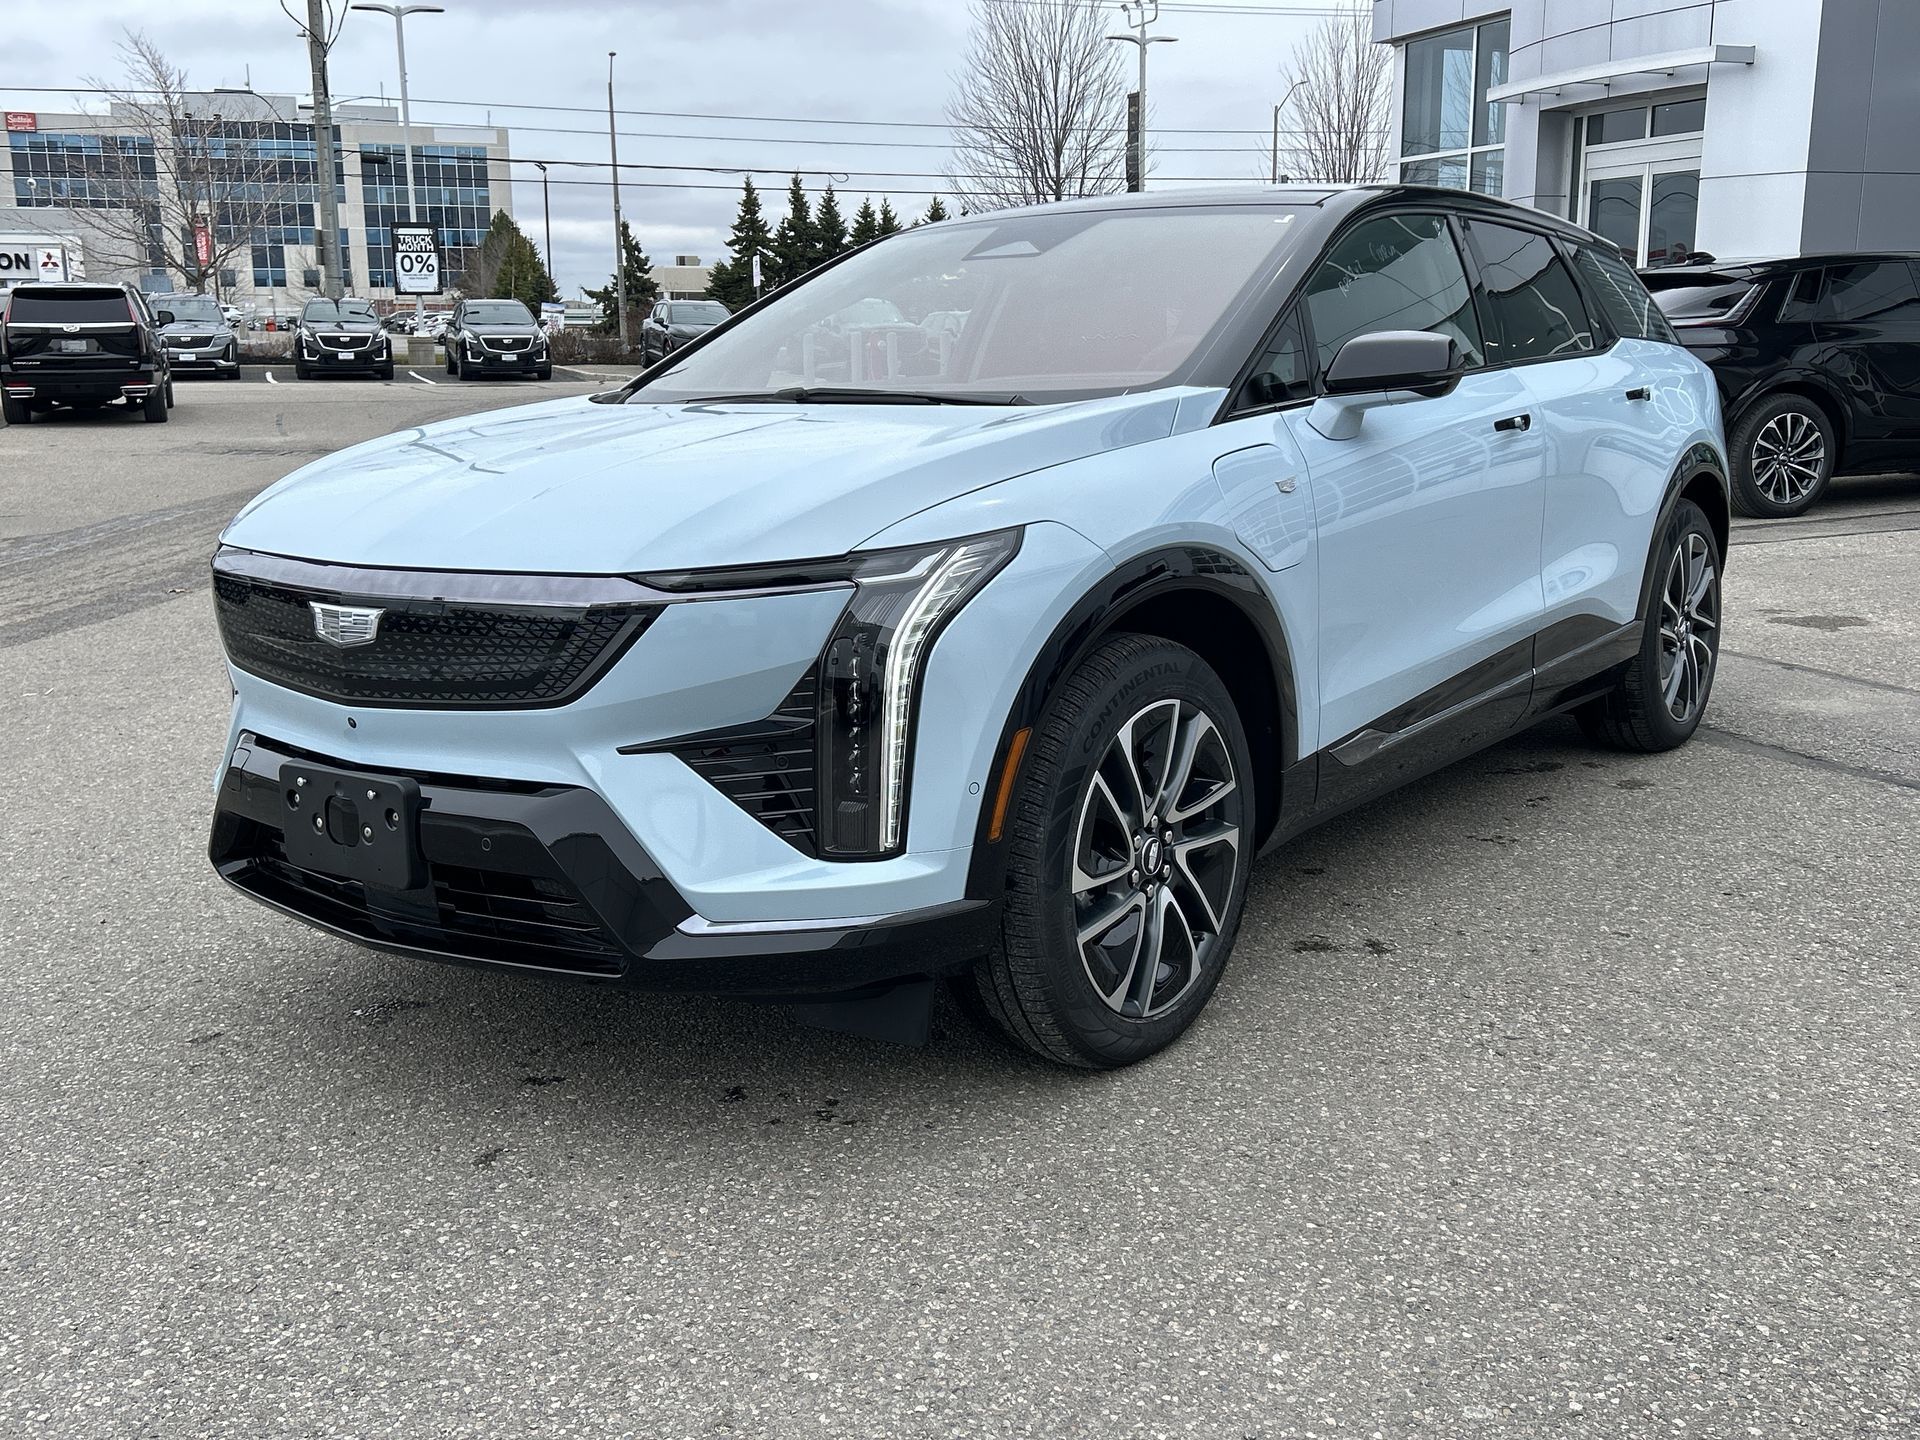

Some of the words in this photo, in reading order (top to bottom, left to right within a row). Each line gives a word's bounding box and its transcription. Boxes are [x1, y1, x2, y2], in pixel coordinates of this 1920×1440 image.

[398, 235, 432, 244] TRUCK
[398, 243, 434, 251] MONTH
[400, 254, 435, 274] 0%
[1082, 661, 1182, 754] CONTINENTAL
